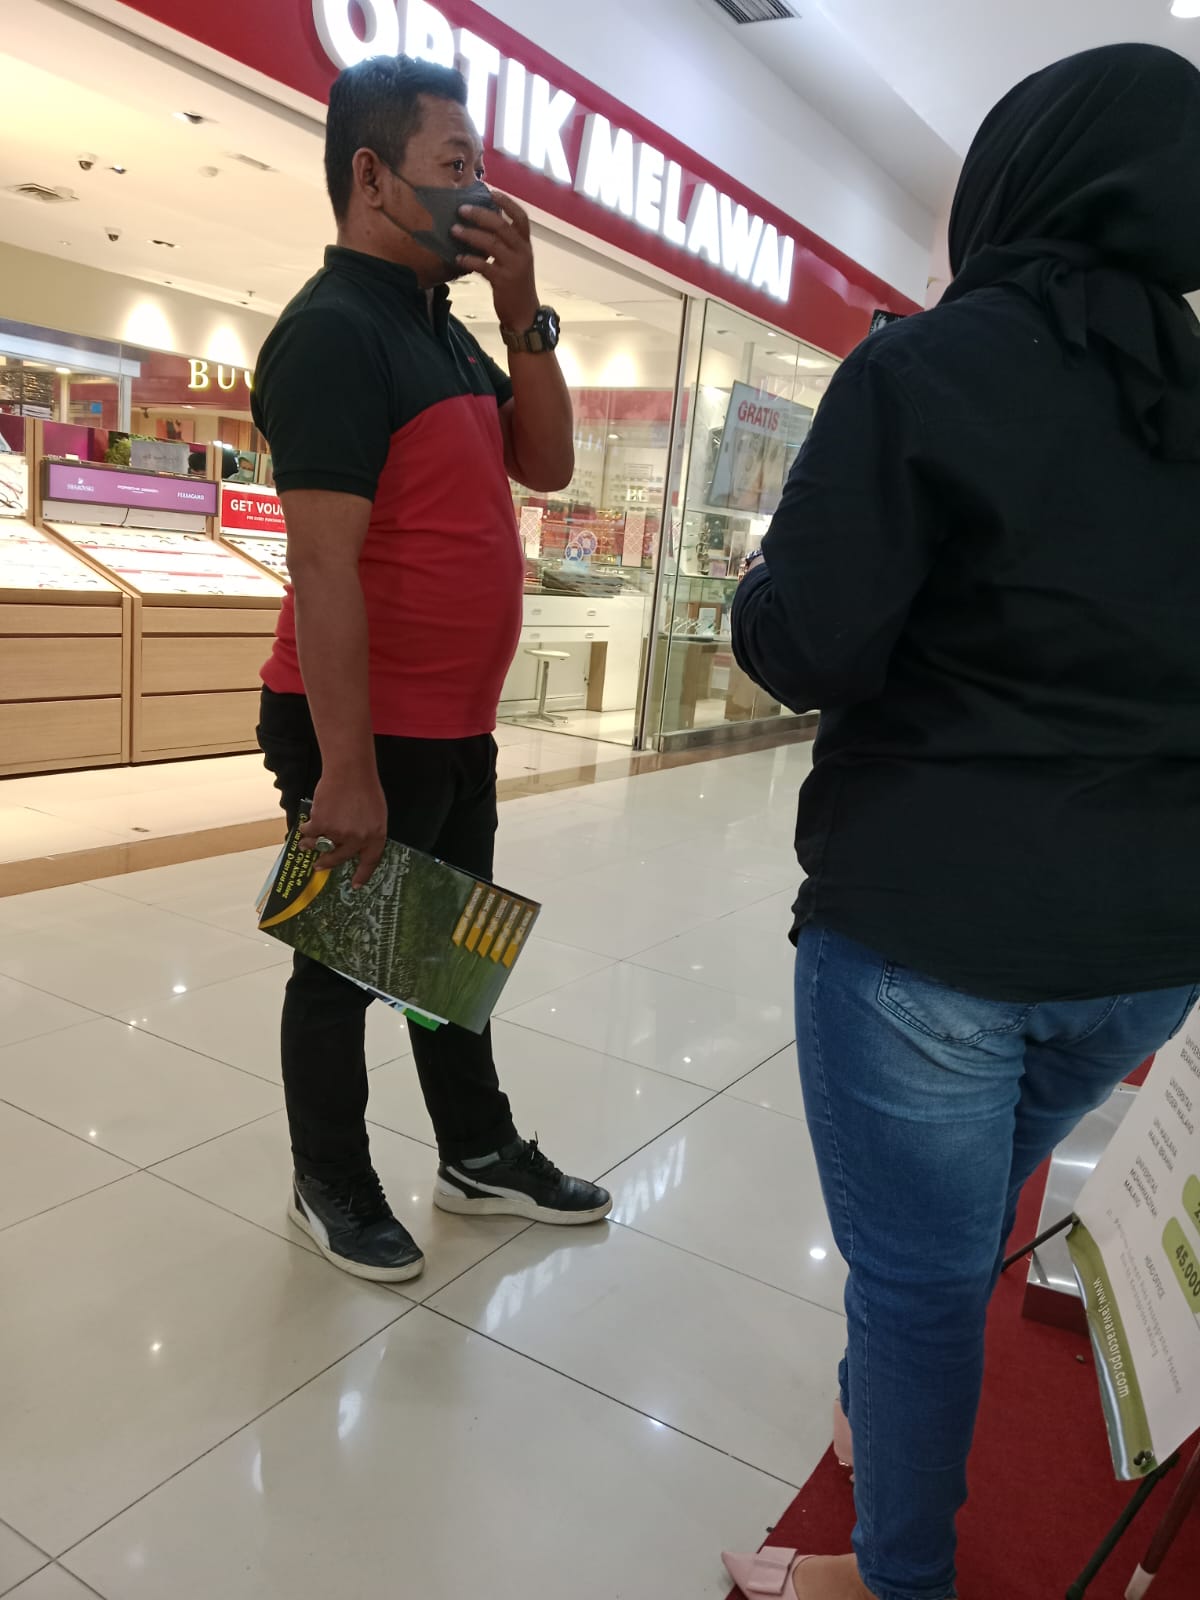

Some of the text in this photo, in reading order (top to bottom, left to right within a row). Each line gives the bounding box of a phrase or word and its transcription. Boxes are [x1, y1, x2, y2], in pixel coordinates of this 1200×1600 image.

[312, 0, 795, 304] OPTIK MELAWAI
[737, 400, 780, 432] GRATIS
[230, 498, 253, 513] GET
[1175, 1244, 1200, 1297] 45.000
[1093, 1276, 1130, 1398] www.jawaracorpo.com
